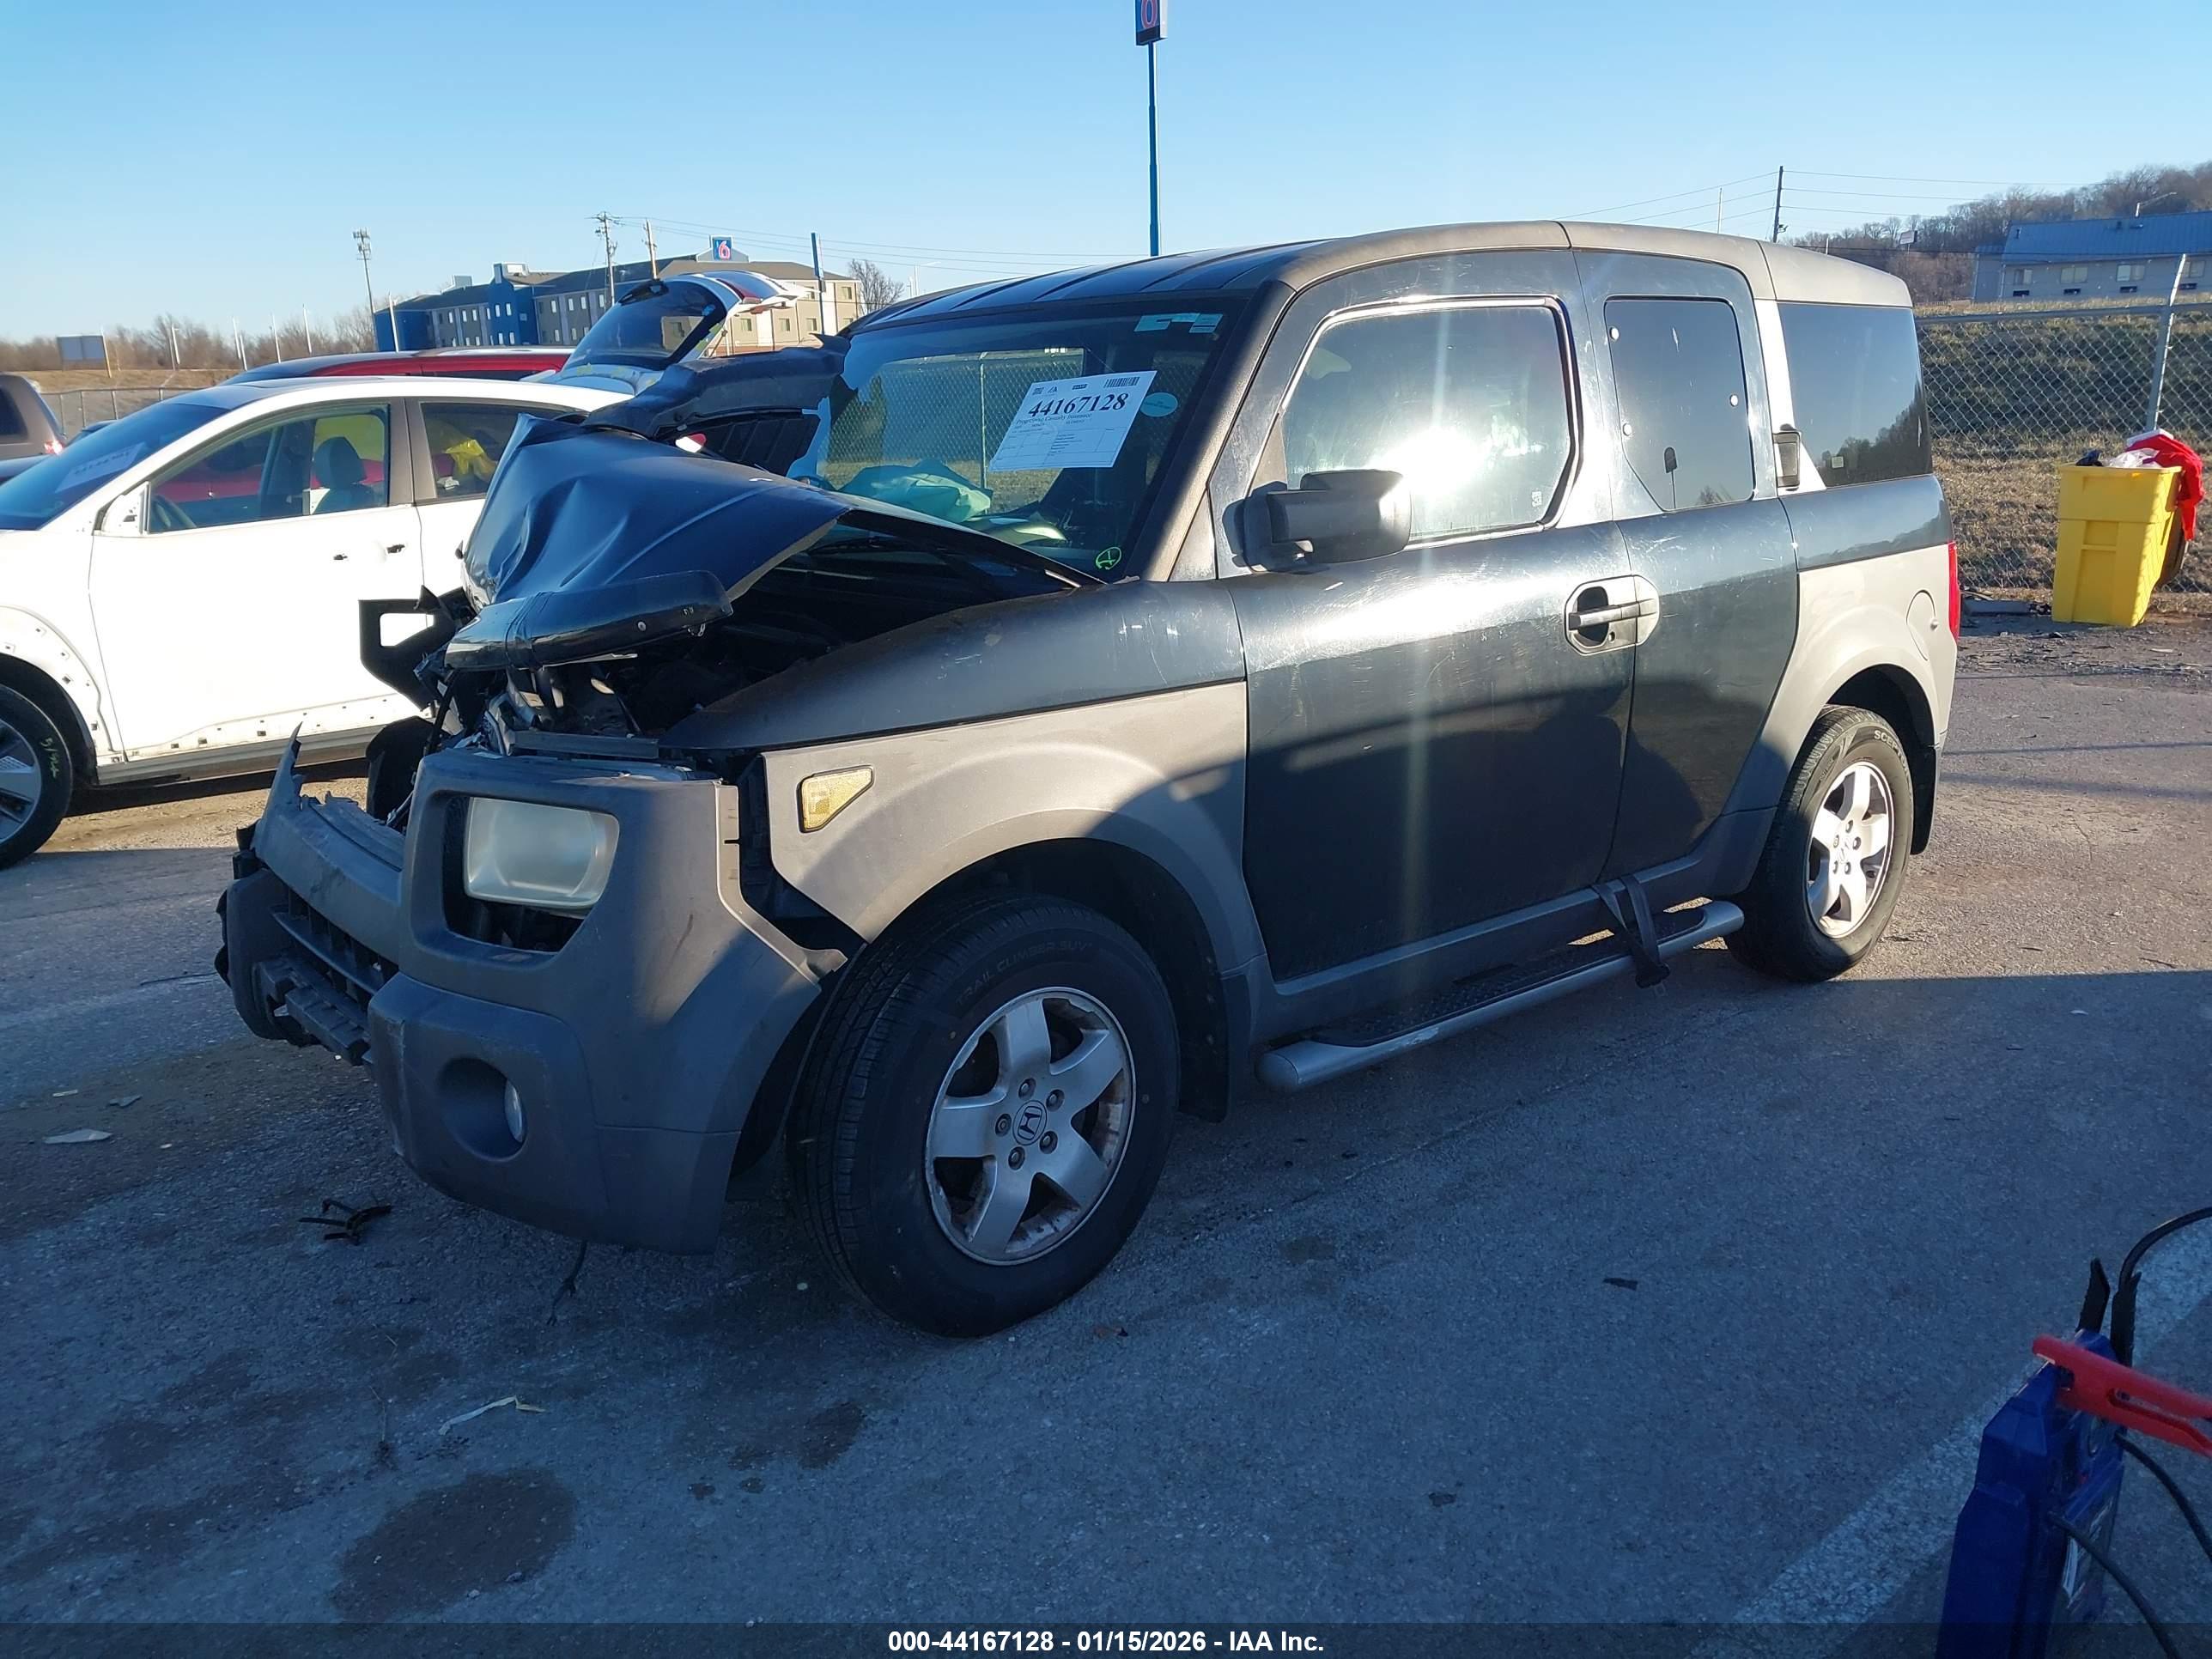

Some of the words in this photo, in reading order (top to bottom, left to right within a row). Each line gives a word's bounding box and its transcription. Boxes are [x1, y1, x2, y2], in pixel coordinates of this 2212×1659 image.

[719, 240, 730, 259] 6
[1028, 392, 1129, 417] 44167128
[956, 970, 995, 1006] TRAIL
[996, 942, 1056, 973] CLIMBER
[1059, 940, 1089, 952] SUV
